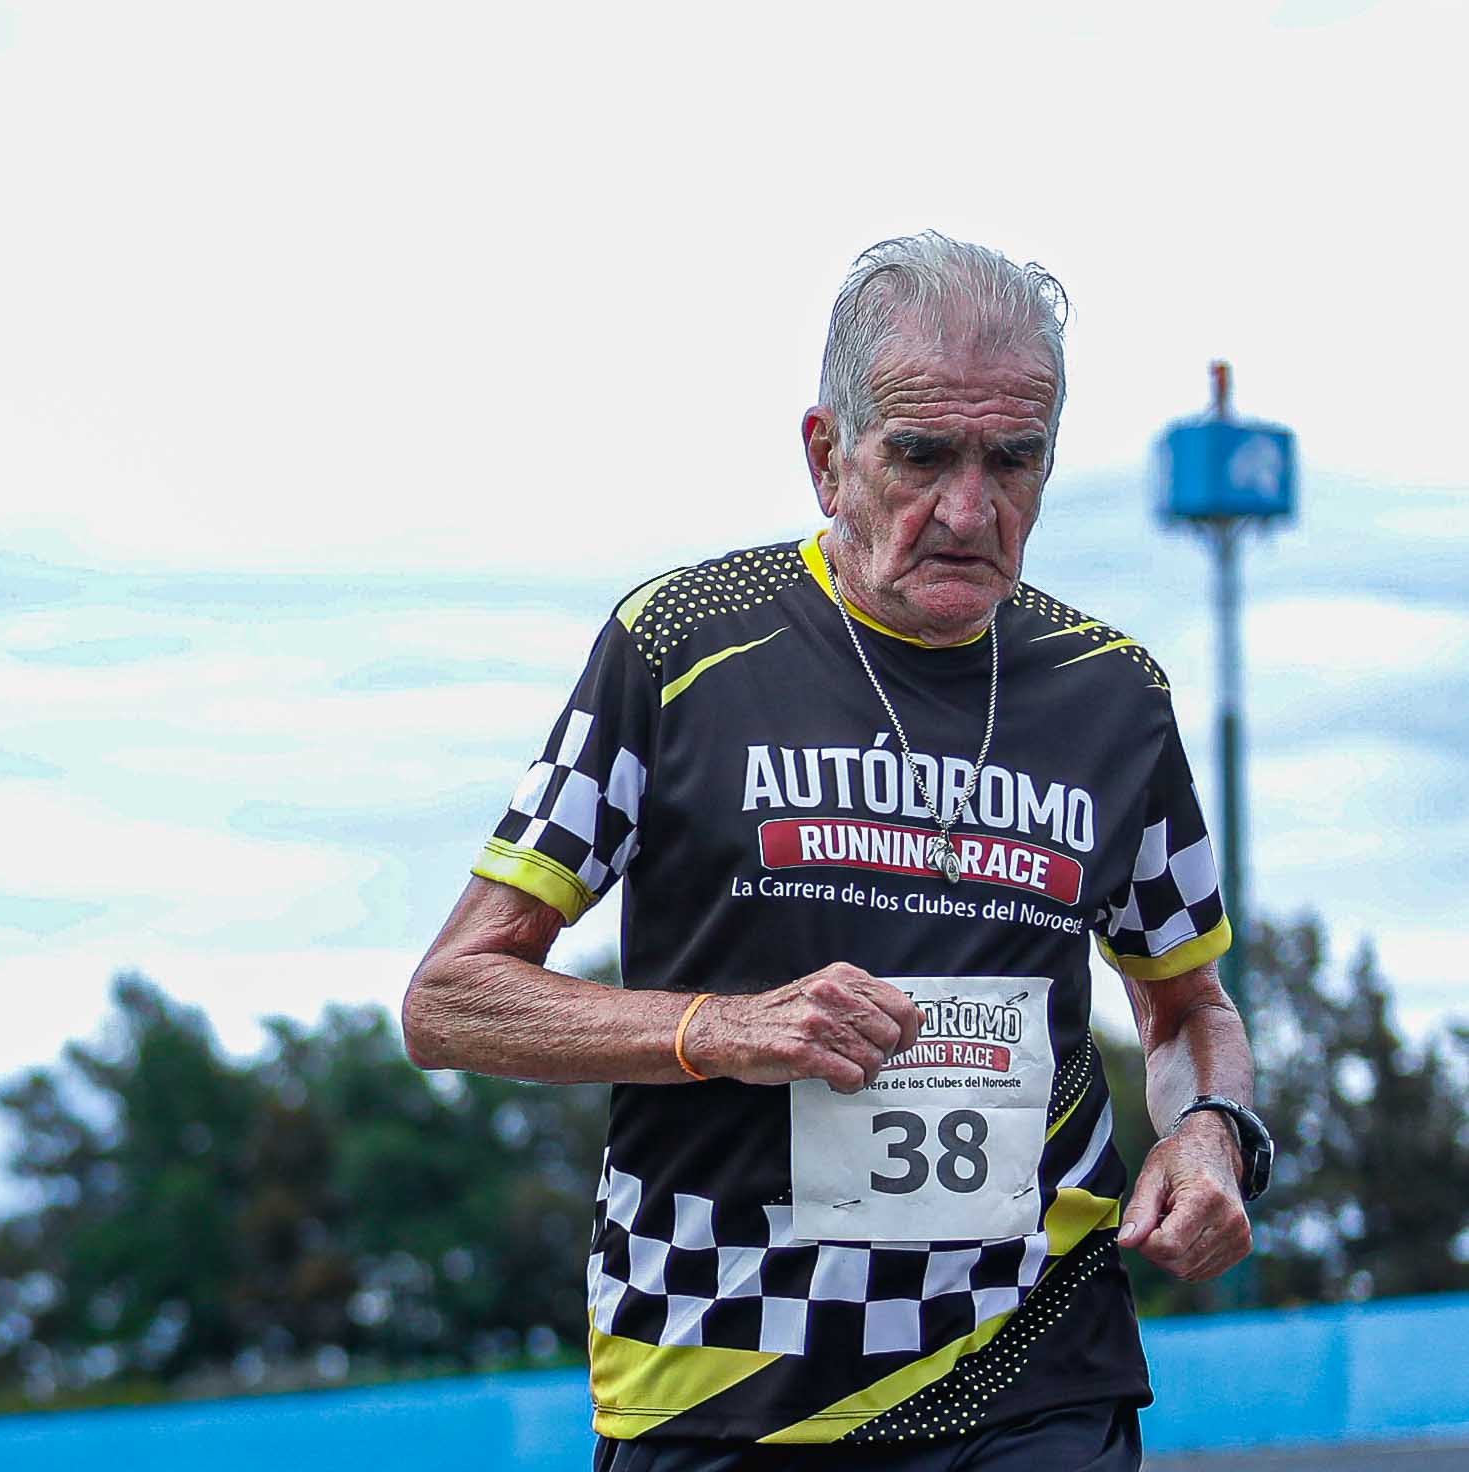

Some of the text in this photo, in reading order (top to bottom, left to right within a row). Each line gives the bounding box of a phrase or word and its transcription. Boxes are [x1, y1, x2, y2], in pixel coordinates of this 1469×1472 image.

[741, 732, 1096, 853] AUTÓDROMO
[960, 839, 1051, 890] RACE
[731, 876, 753, 897] La
[759, 876, 836, 901] Carrera
[841, 882, 865, 905] de
[870, 887, 899, 911] los
[904, 892, 976, 921] Clubes
[982, 899, 1015, 922] del
[906, 992, 1022, 1043] DROMO
[952, 1044, 994, 1068] RACE
[891, 1077, 906, 1090] de
[909, 1077, 925, 1089] los
[926, 1076, 963, 1089] Clubes
[964, 1076, 981, 1088] del
[982, 1077, 1022, 1088] Noroeste
[870, 1109, 988, 1194] 38
